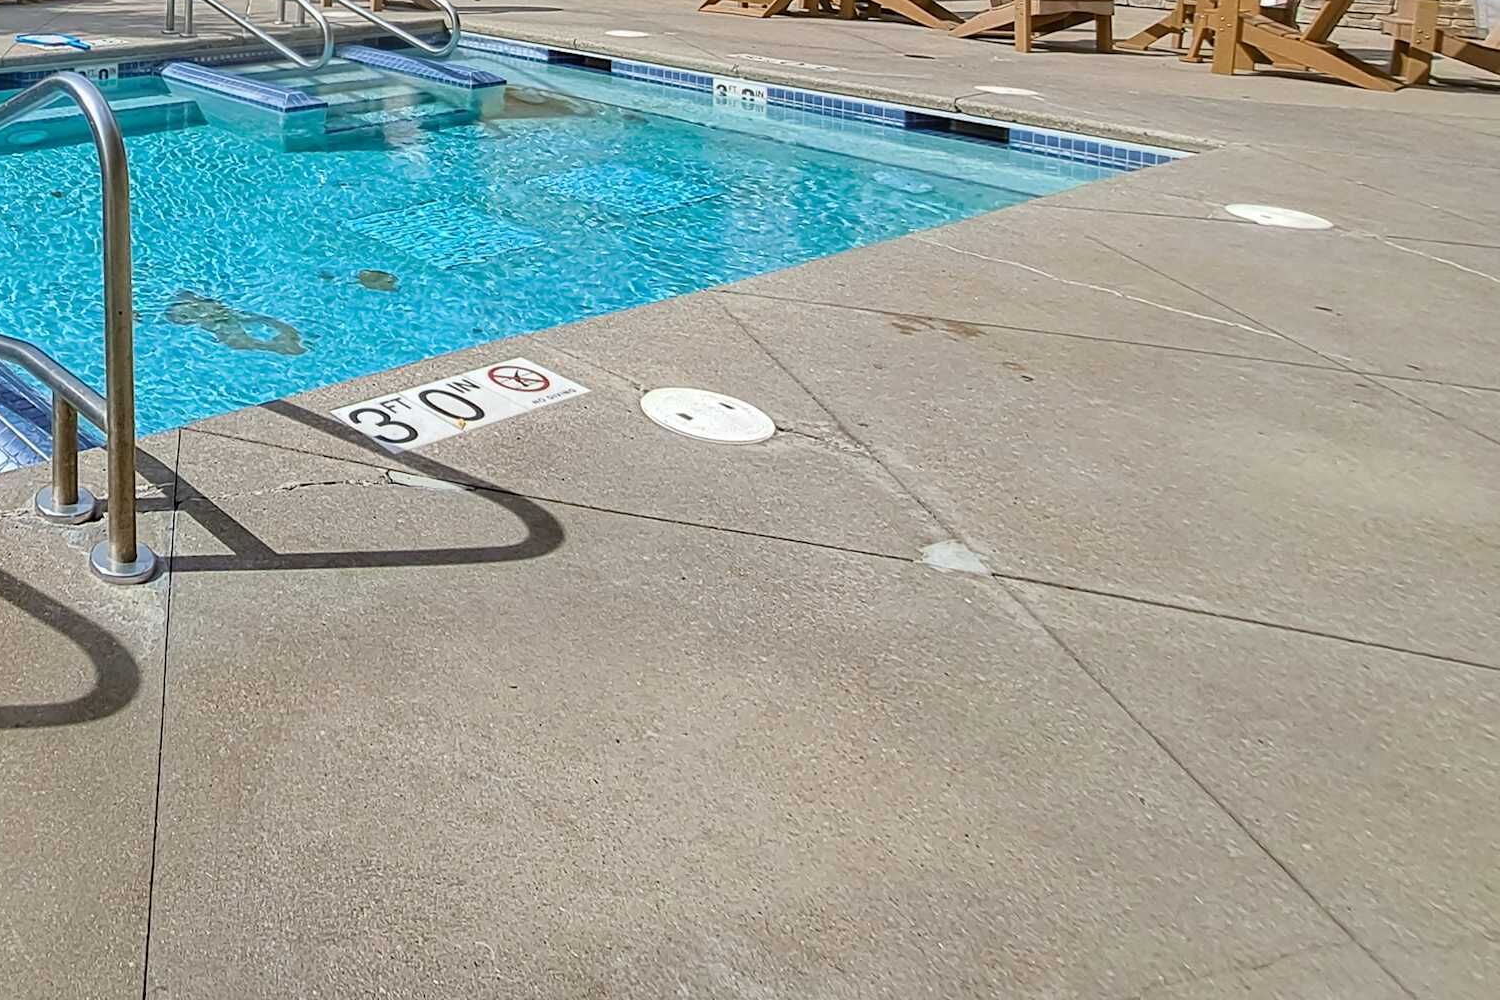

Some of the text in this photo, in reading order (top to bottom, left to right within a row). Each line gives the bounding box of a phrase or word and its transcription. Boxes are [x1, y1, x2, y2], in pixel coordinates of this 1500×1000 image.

[348, 377, 485, 444] 3 FT 0 IN
[546, 387, 577, 400] DIVING
